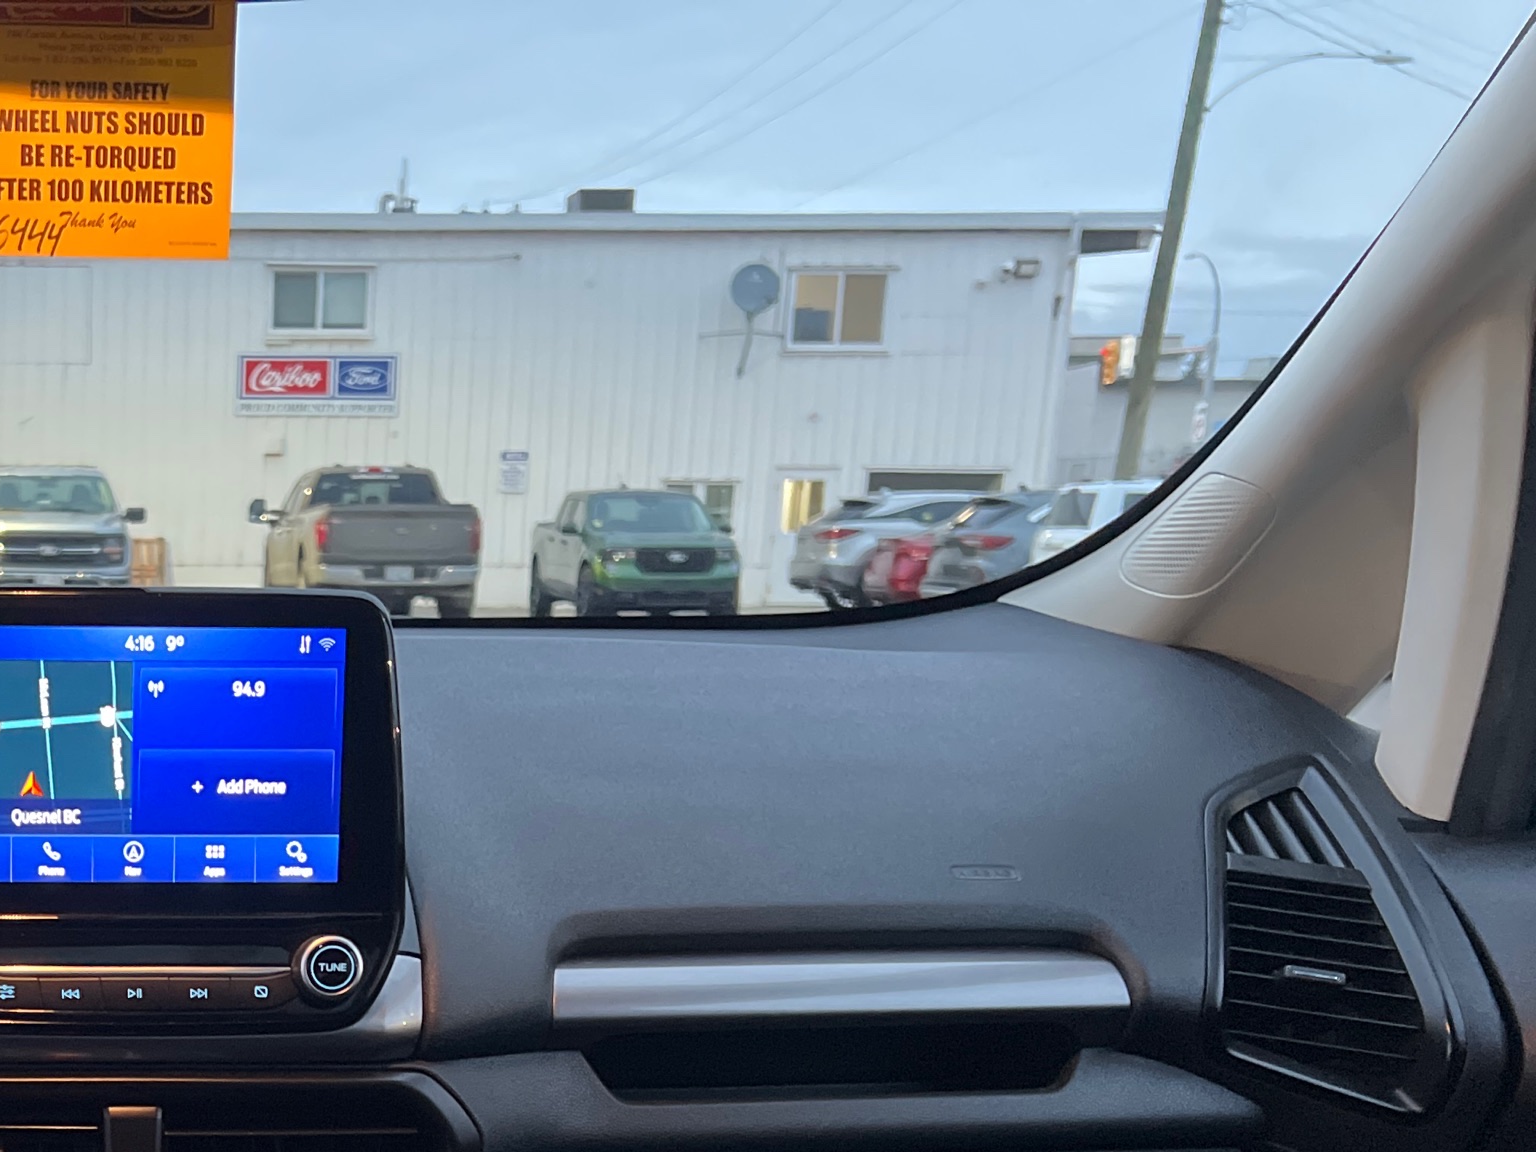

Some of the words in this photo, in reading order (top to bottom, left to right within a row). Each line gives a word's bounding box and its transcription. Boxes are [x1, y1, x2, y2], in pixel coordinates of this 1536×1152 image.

[30, 80, 60, 99] FOR
[65, 81, 108, 100] YOUR
[112, 82, 170, 101] SAFETY
[66, 110, 119, 135] NUTS
[124, 112, 205, 136] SHOULD
[20, 144, 45, 167] BE
[50, 145, 177, 172] RE-TORQUED
[47, 178, 84, 202] 100
[90, 180, 213, 205] KILOMETERS
[59, 211, 105, 229] Thank
[109, 212, 136, 233] You
[248, 361, 323, 392] Cariboo
[346, 367, 382, 386] Ford
[125, 635, 155, 651] 4:16
[232, 680, 266, 697] 94.9
[217, 779, 244, 794] Add
[245, 779, 287, 794] Phone
[11, 808, 62, 827] Quesnel
[63, 809, 81, 825] BC
[317, 962, 348, 973] TUNE
